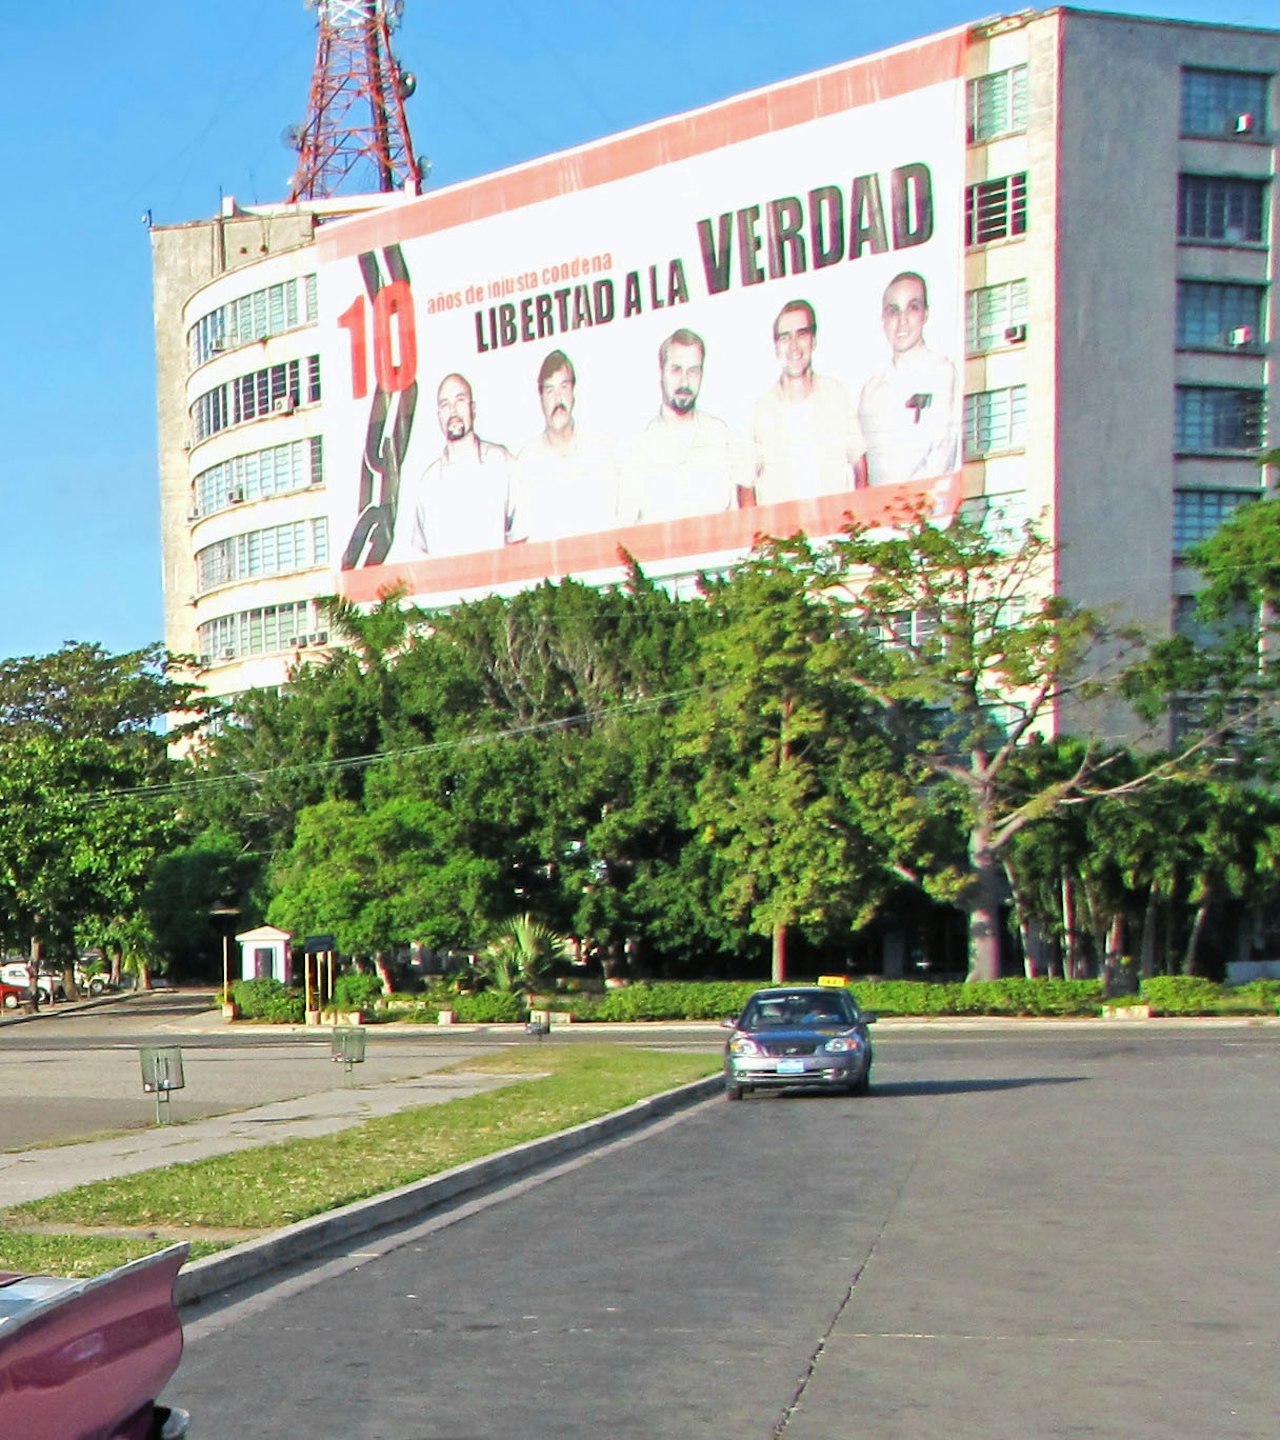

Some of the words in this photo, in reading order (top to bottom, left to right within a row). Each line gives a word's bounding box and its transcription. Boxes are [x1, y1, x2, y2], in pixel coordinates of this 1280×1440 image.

[427, 293, 462, 315] años
[465, 285, 484, 304] de
[487, 272, 539, 299] injusta
[542, 253, 613, 285] condena
[475, 278, 616, 353] LIBERTAD
[624, 271, 642, 318] A
[649, 258, 690, 310] LA
[696, 162, 935, 295] VERDAD
[337, 280, 417, 400] 10
